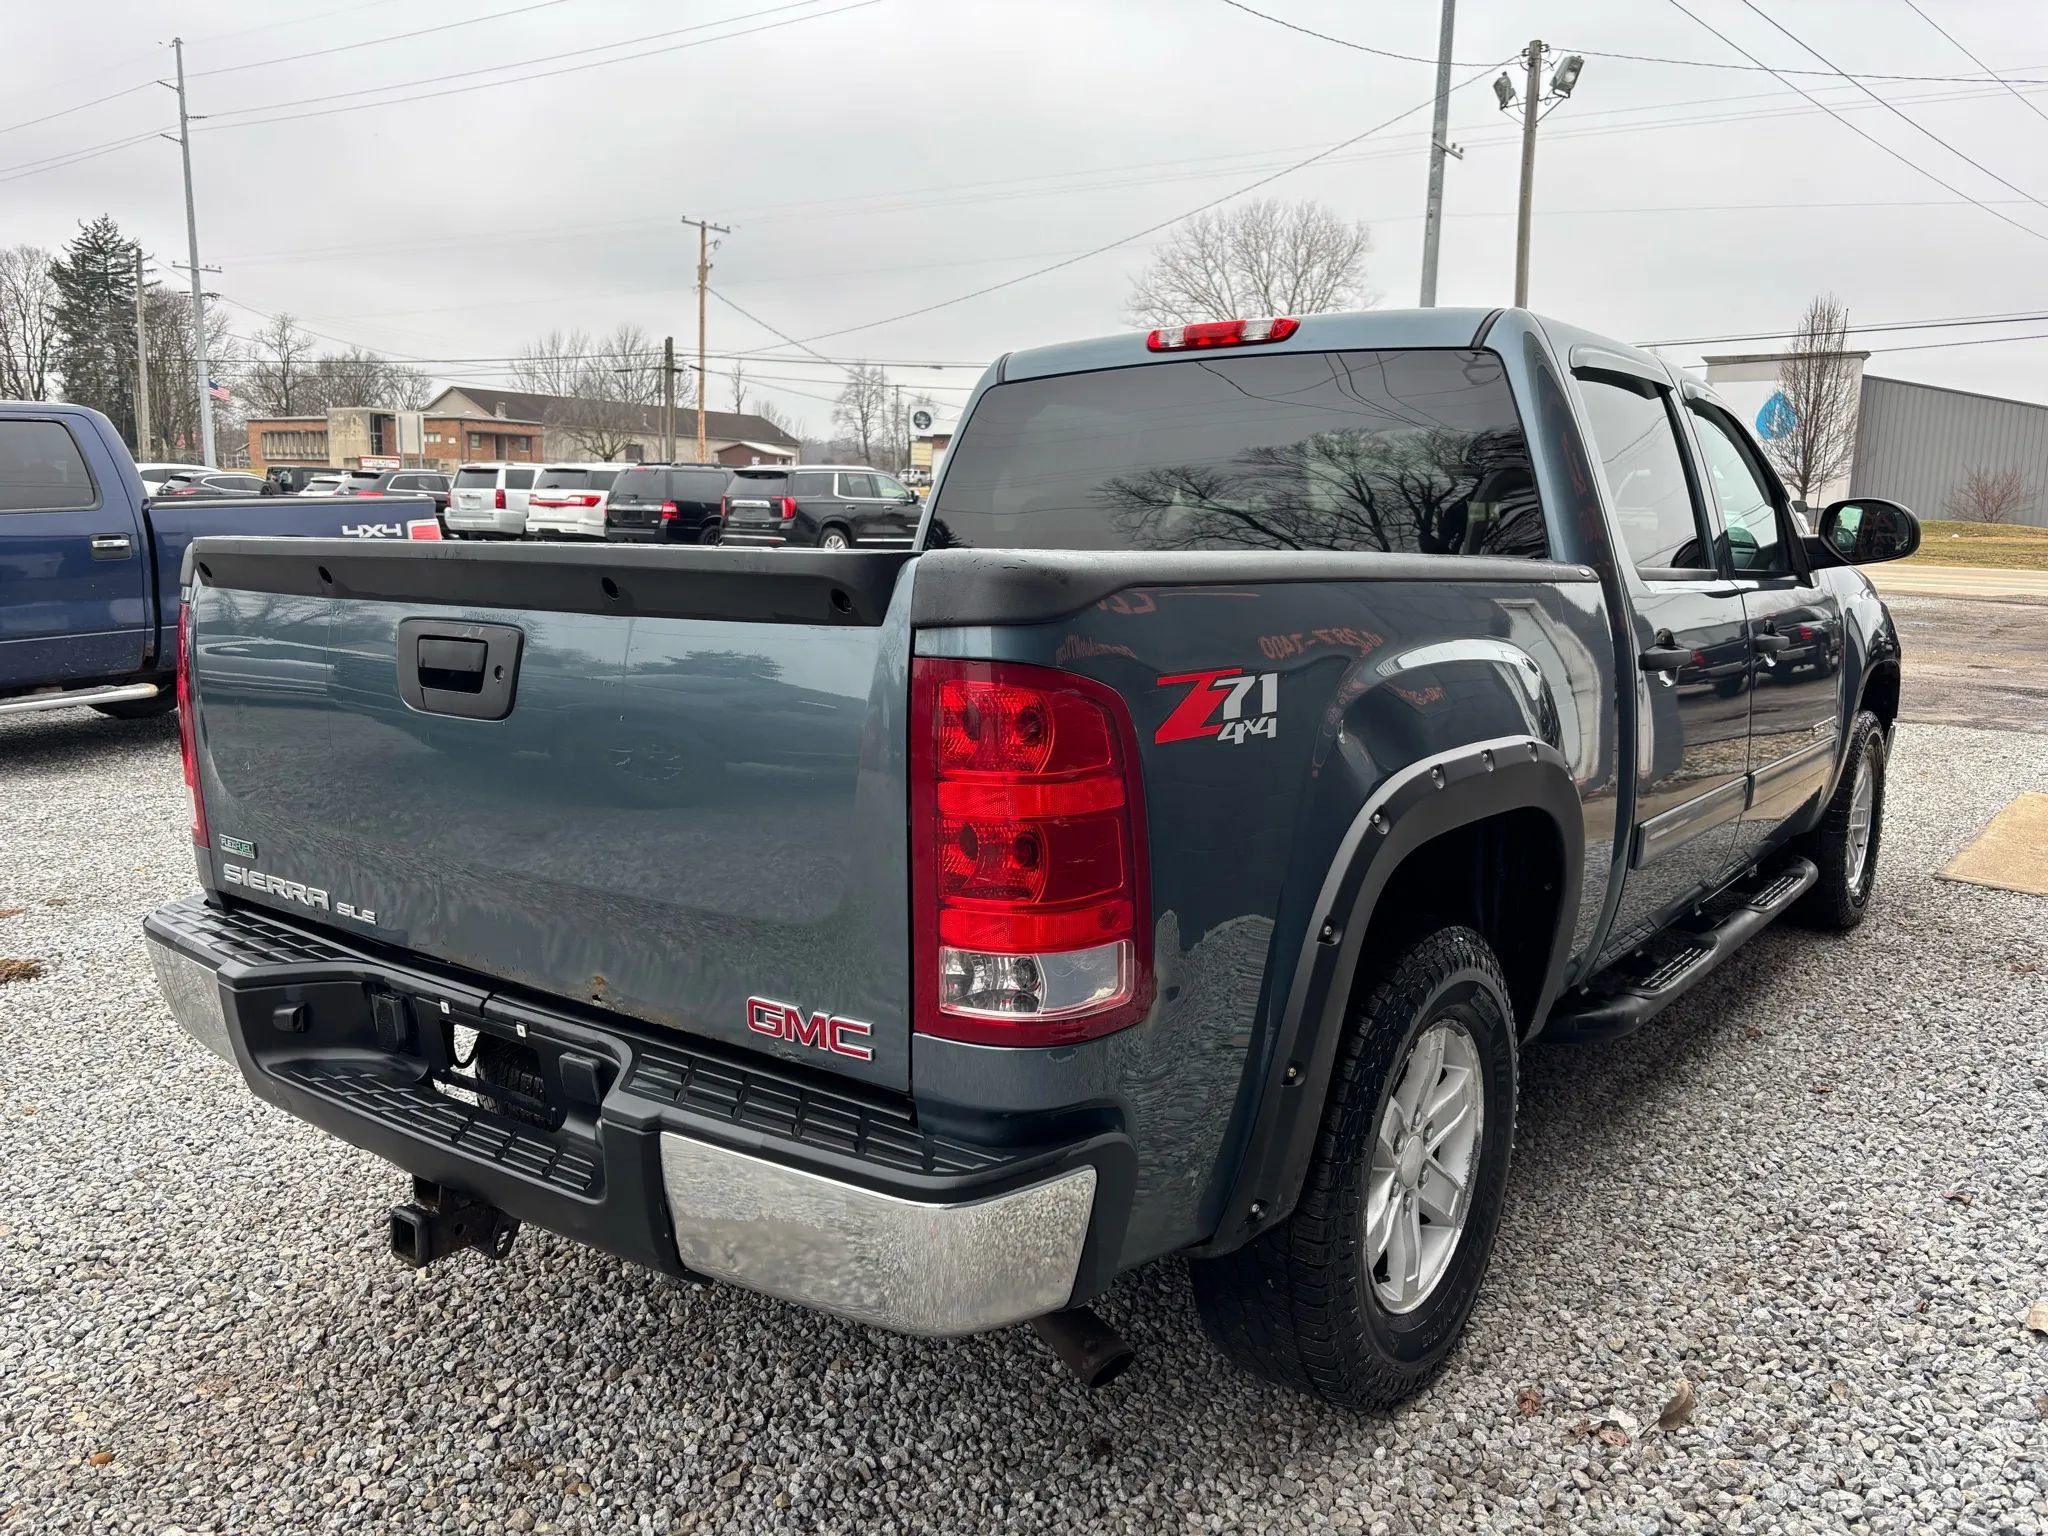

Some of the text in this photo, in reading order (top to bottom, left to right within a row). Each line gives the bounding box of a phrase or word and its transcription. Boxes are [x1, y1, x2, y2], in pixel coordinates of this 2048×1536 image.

[1155, 667, 1278, 744] Z71
[223, 863, 376, 925] SIERRA SLE
[746, 996, 872, 1061] GMC
